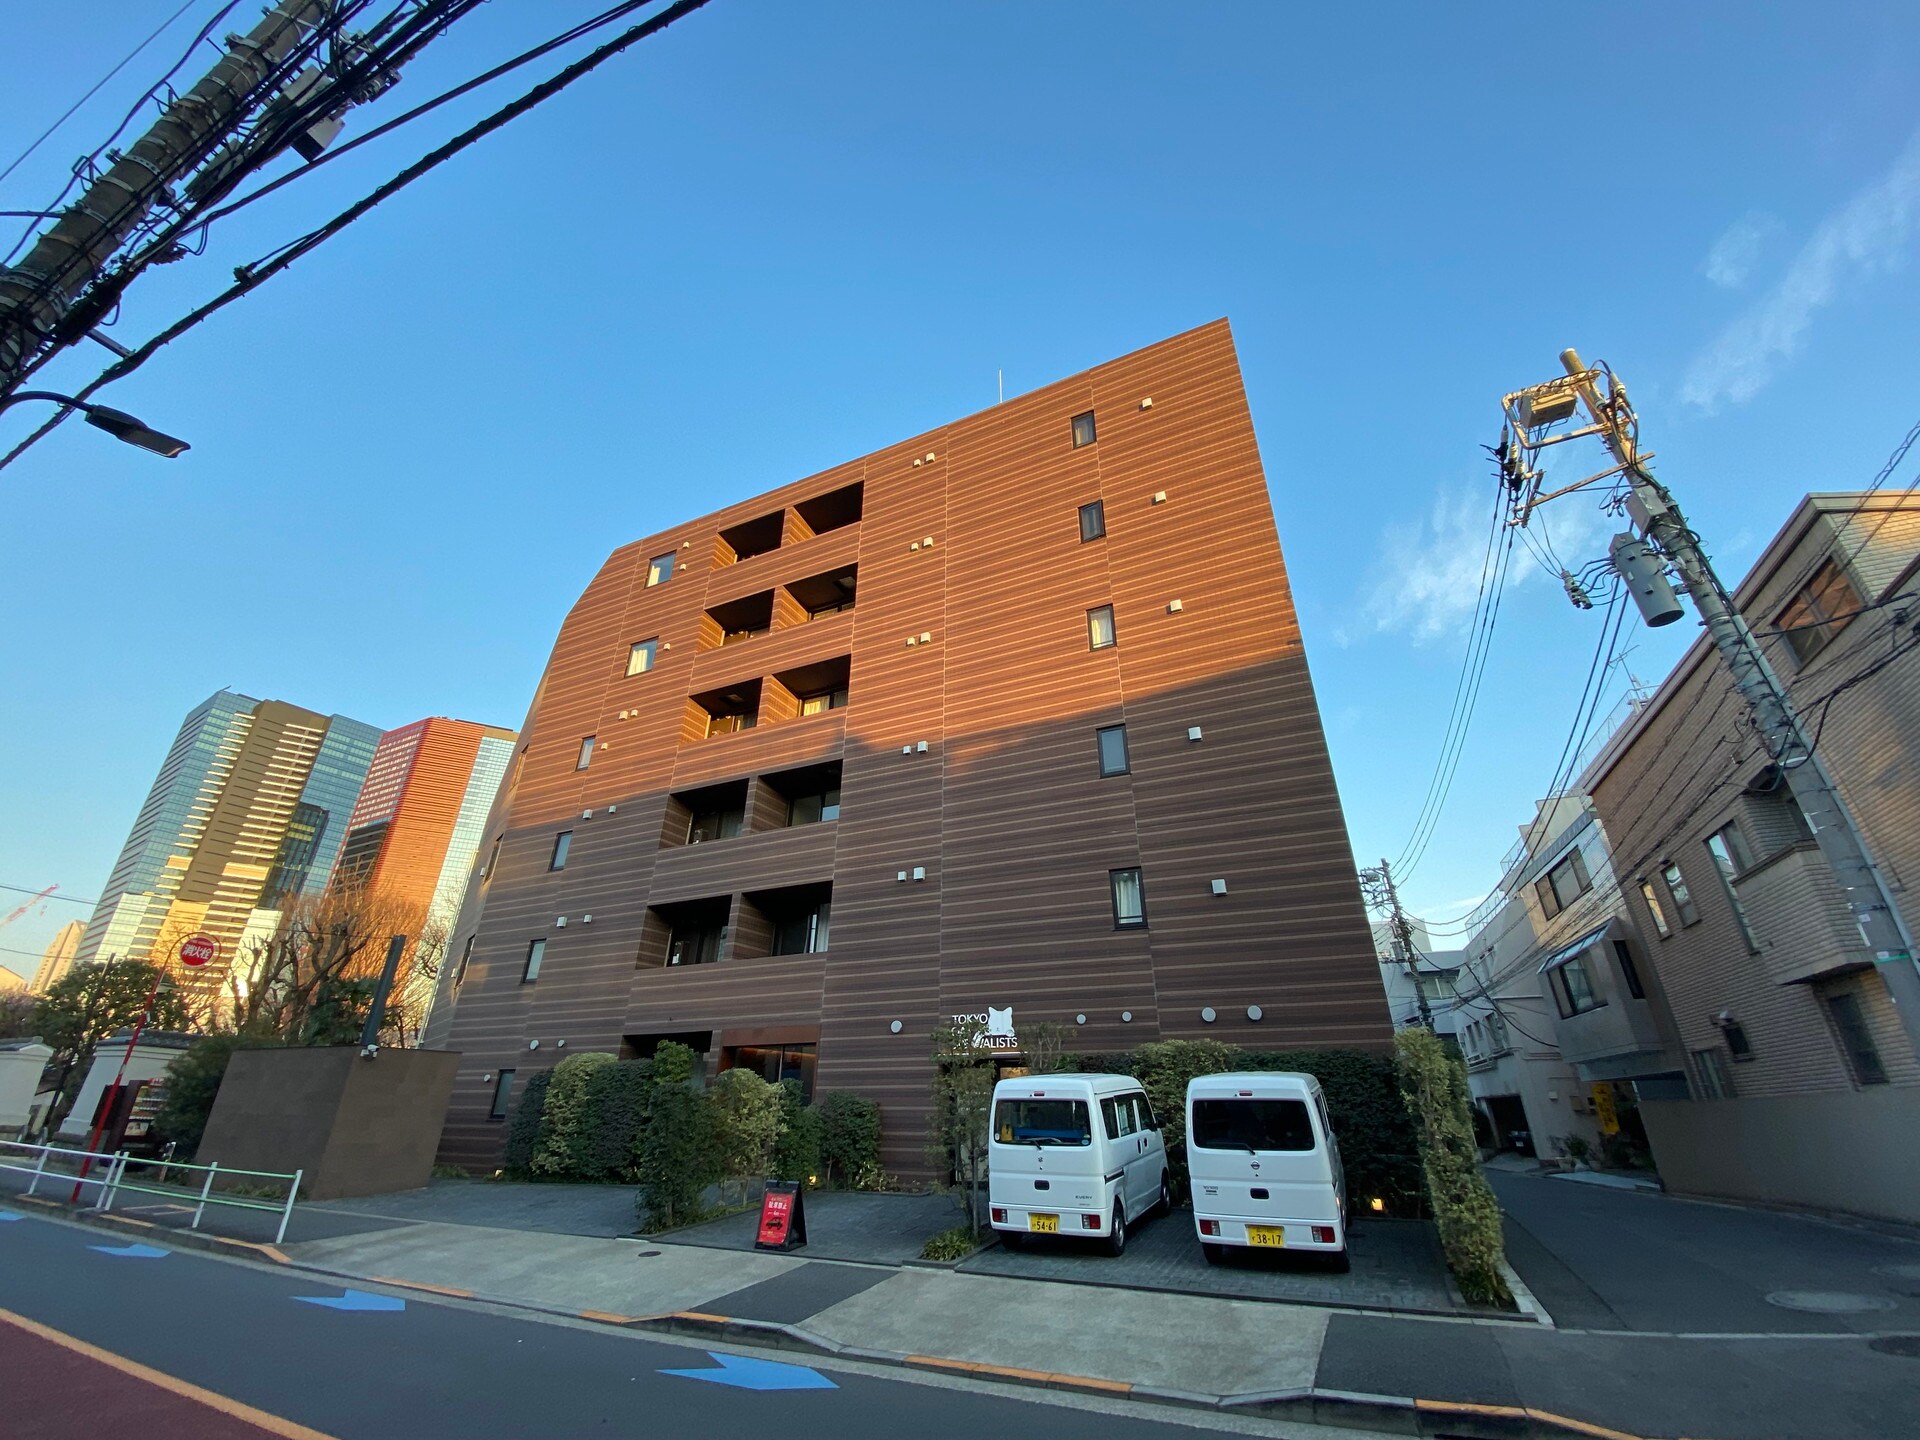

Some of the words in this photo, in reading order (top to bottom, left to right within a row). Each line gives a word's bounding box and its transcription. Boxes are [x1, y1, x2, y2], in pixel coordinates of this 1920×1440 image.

[182, 944, 212, 960] 消火栓
[952, 1013, 988, 1025] TOKYO
[1036, 1220, 1057, 1231] 54-61
[1256, 1233, 1281, 1245] 38-17
